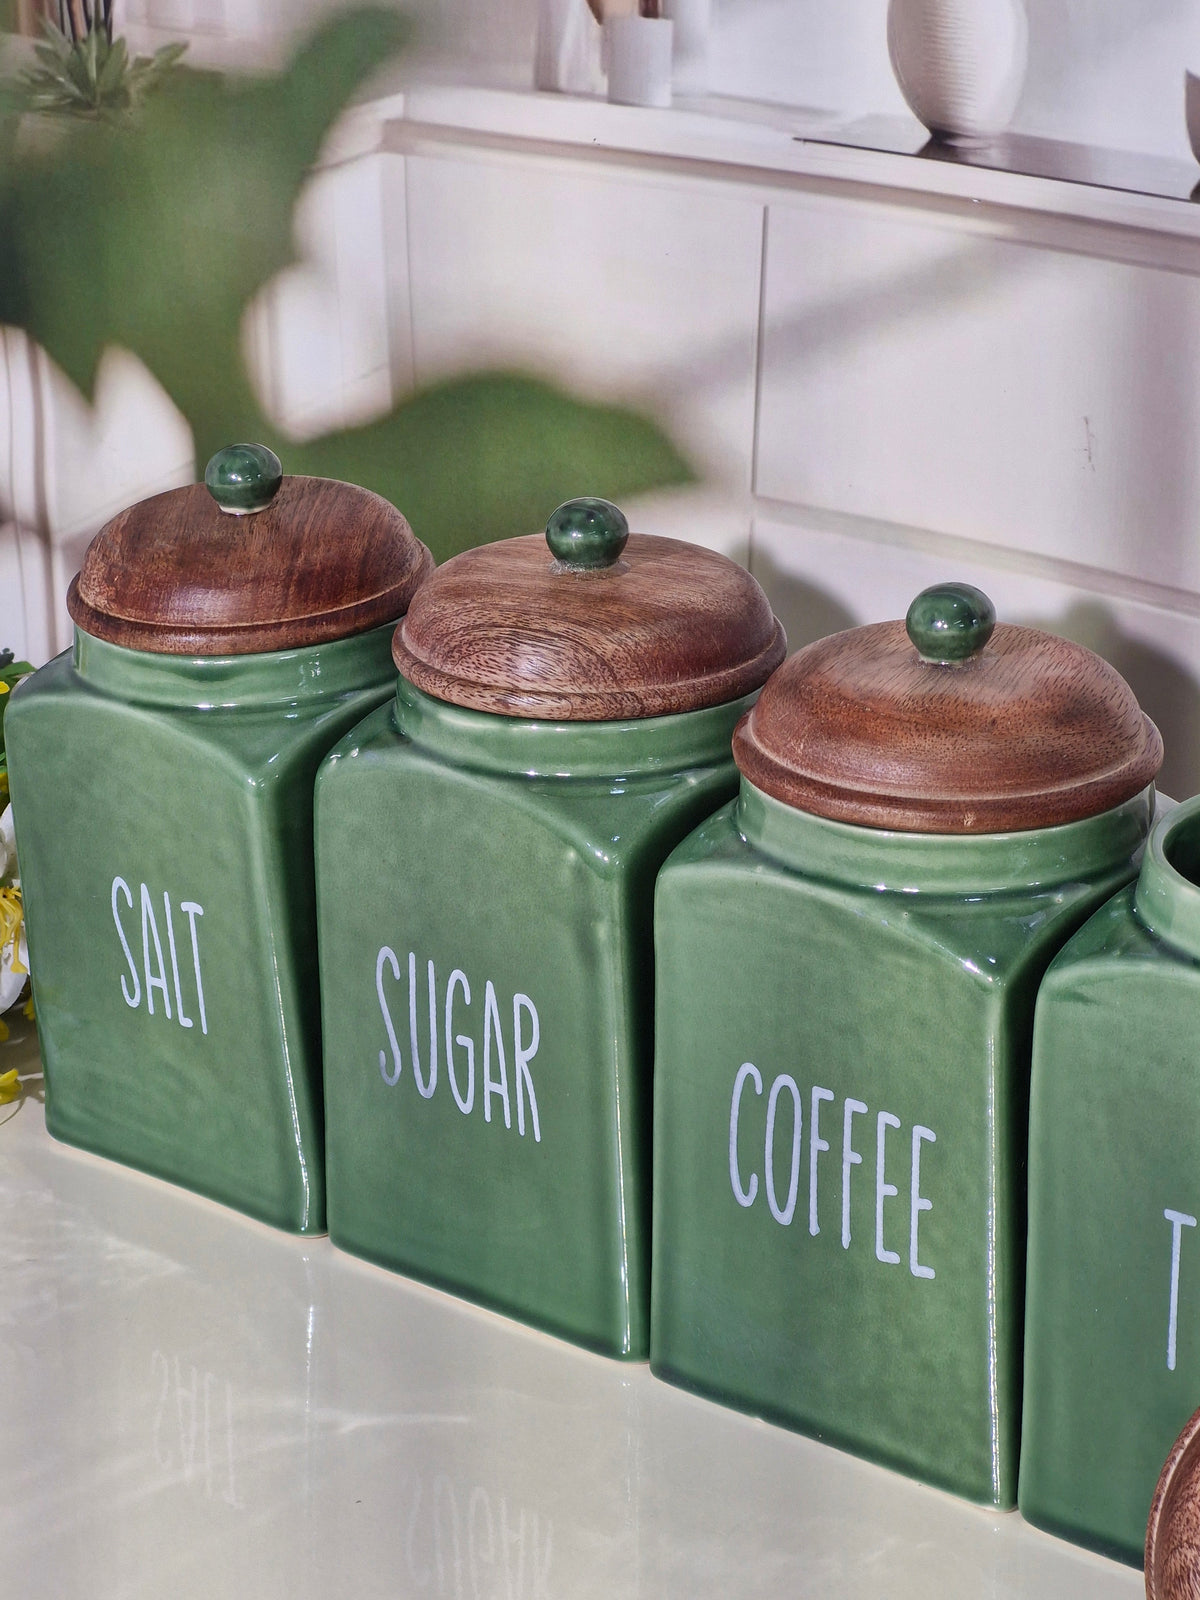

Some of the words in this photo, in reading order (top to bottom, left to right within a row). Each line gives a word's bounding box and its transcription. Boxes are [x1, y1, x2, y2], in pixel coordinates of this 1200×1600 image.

[109, 875, 209, 1036] SALT
[375, 945, 542, 1144] SUGAR
[729, 1062, 938, 1280] COFFEE
